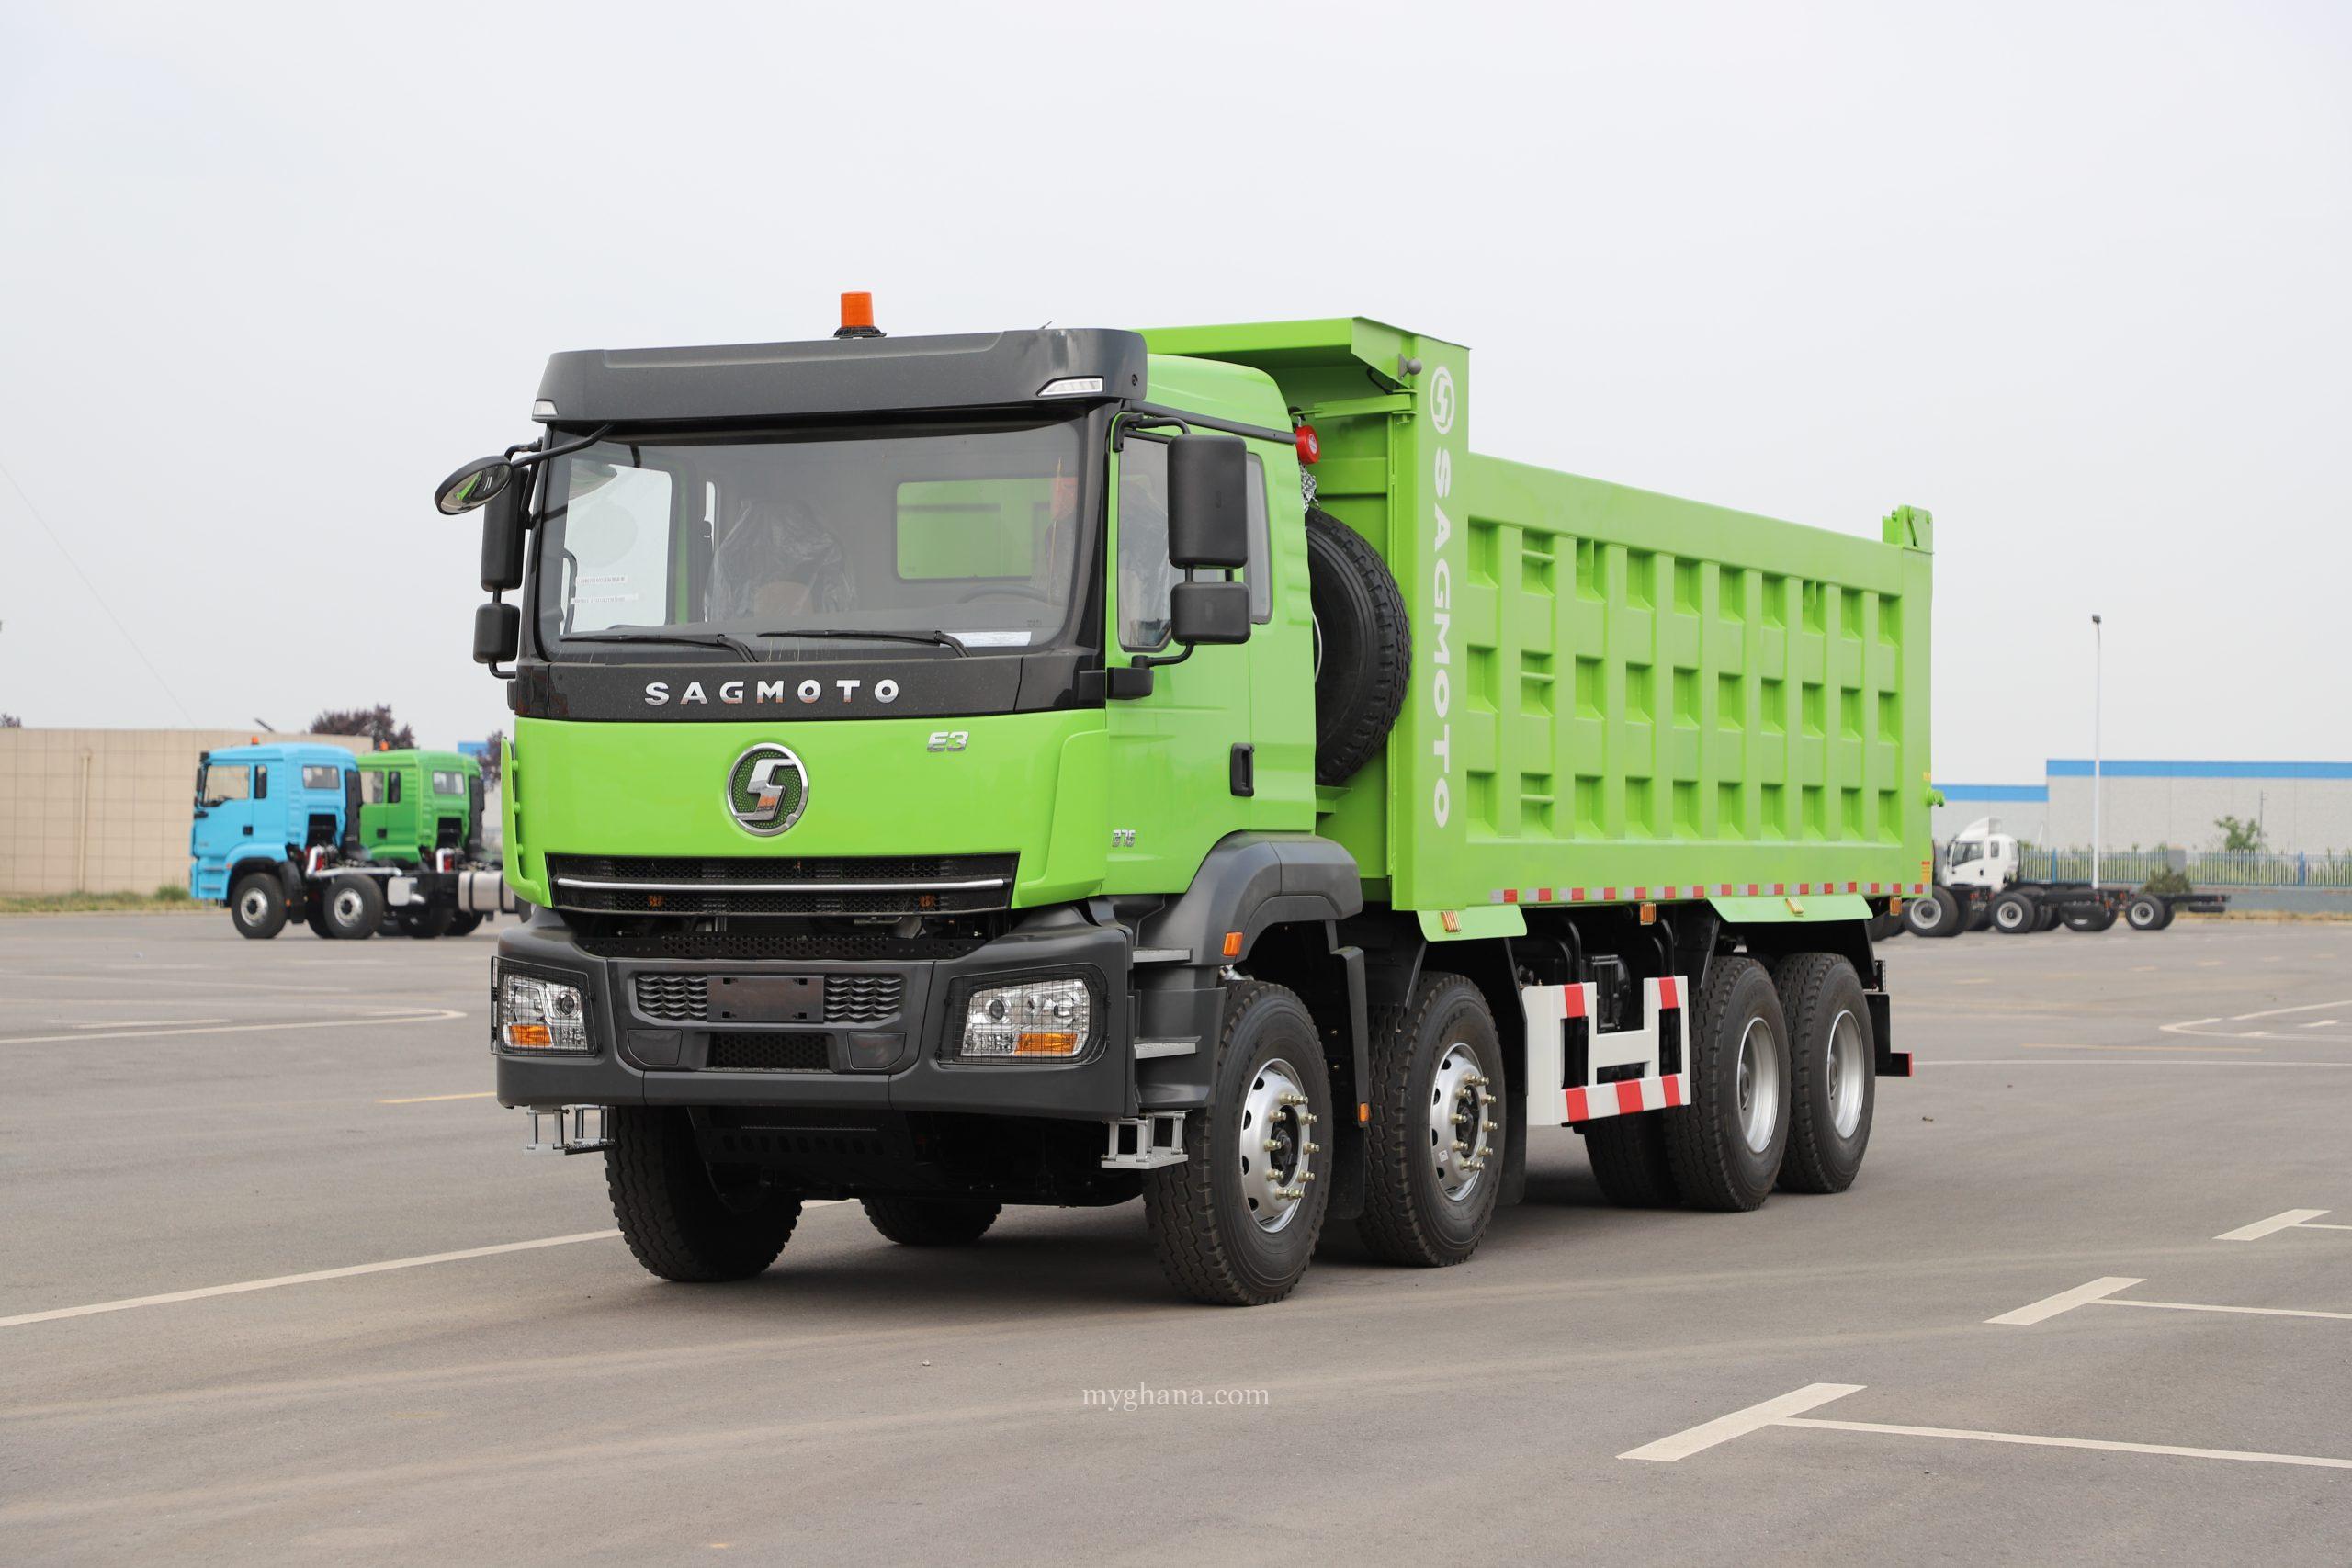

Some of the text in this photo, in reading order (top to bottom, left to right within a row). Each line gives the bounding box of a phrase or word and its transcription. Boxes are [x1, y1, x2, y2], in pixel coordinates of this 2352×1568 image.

[1434, 446, 1452, 829] SAGMOTO
[644, 679, 899, 705] SAGMOTO
[927, 731, 969, 752] E3
